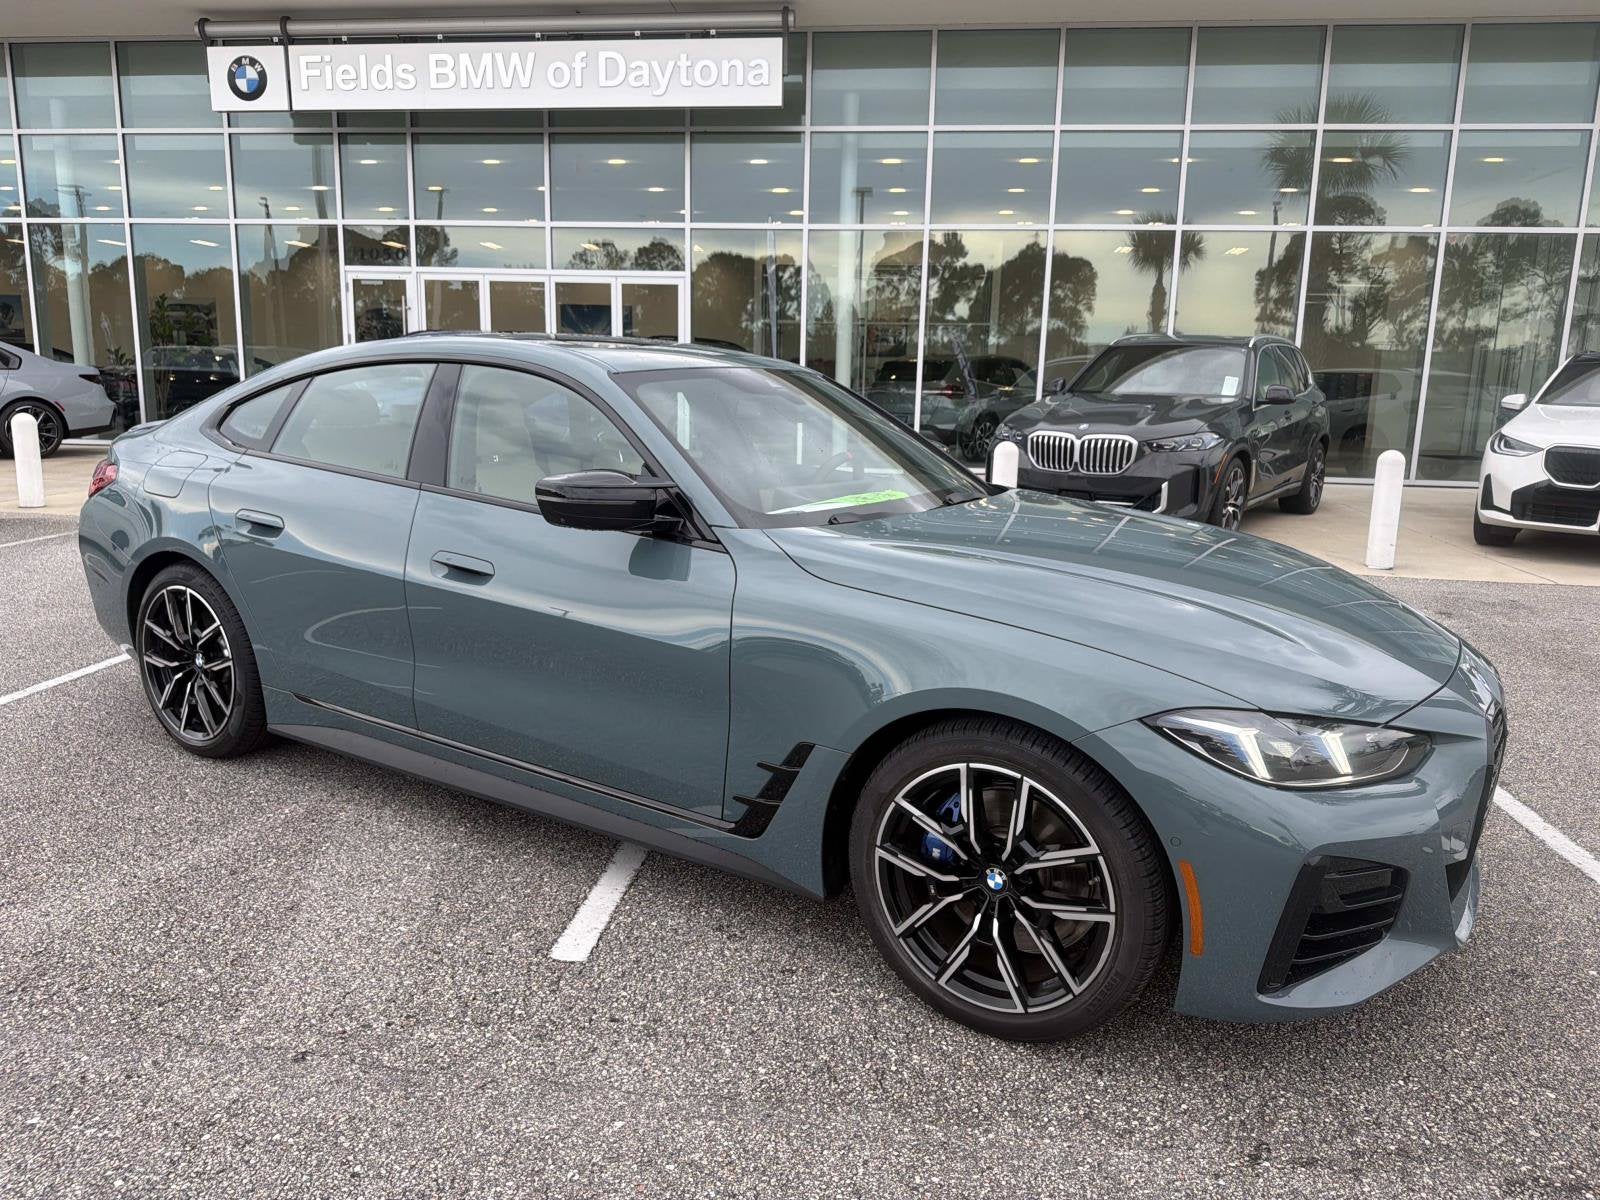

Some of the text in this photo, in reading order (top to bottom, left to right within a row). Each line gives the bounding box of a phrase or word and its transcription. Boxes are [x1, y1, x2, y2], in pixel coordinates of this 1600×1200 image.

[230, 57, 263, 72] BMW
[299, 50, 770, 96] Fields BMW of Daytona
[359, 247, 406, 261] 1050
